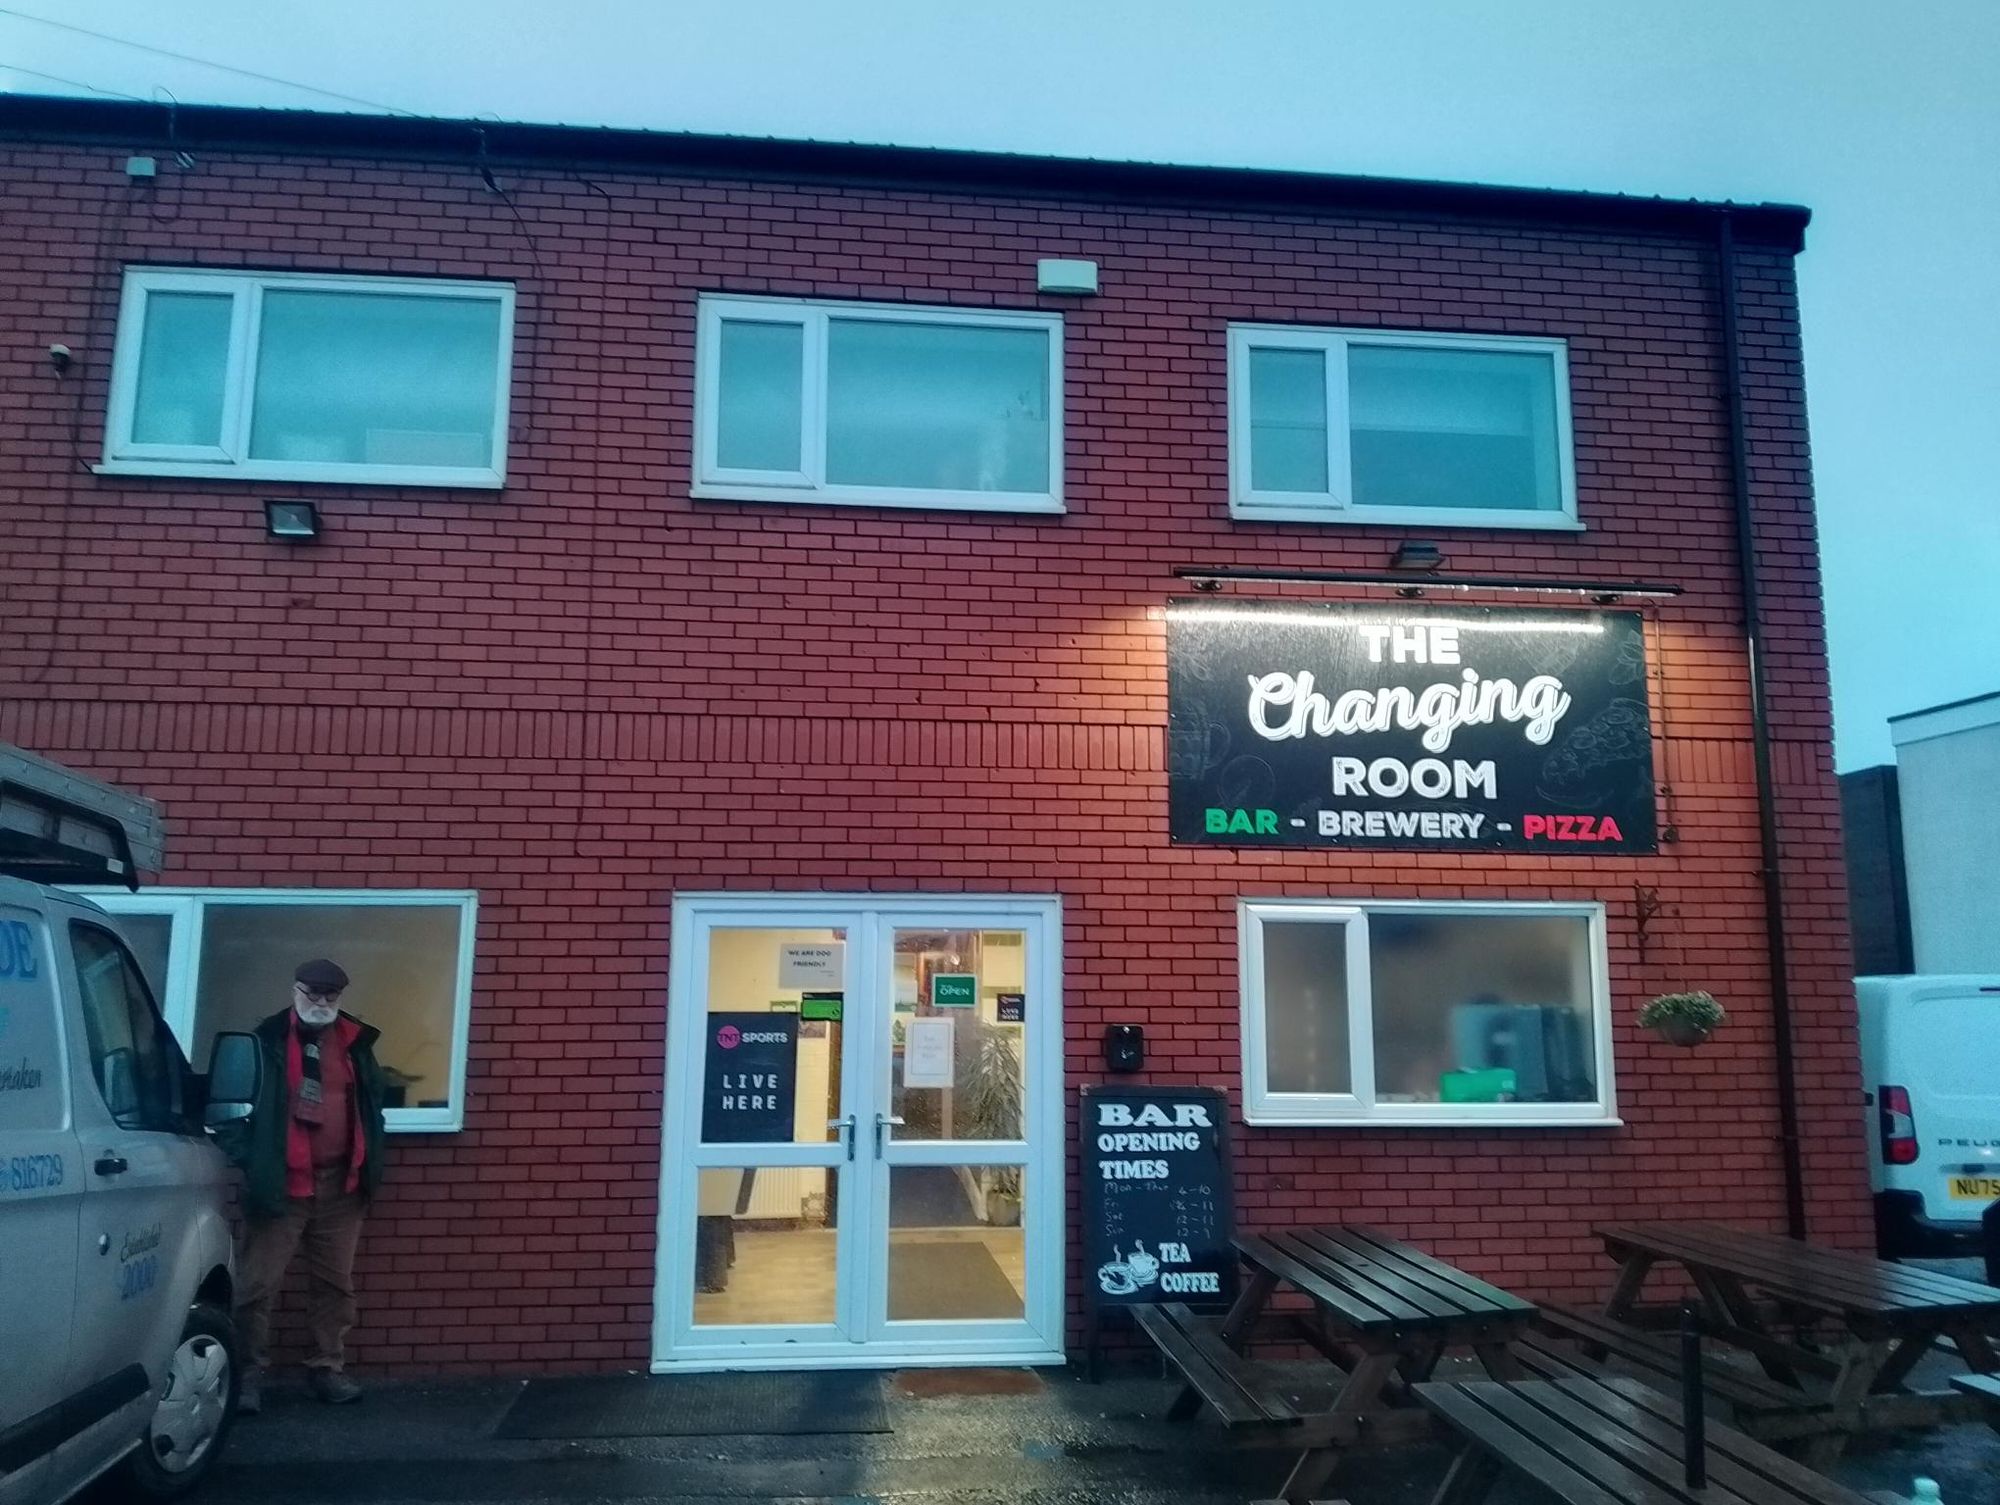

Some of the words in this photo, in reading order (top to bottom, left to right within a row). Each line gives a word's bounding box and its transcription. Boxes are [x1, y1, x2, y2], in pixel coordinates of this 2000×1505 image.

[1359, 624, 1462, 665] THE
[1247, 668, 1572, 753] Changing
[1331, 756, 1498, 800] ROOM
[1205, 808, 1280, 836] BAR
[1317, 810, 1485, 840] BREWERY
[1522, 814, 1623, 842] PIZZA
[742, 1032, 788, 1043] SPORTS
[722, 1073, 778, 1089] LIVE
[722, 1094, 777, 1110] HERE
[1097, 1103, 1213, 1127] BAR
[1097, 1131, 1201, 1152] OPENING
[1098, 1159, 1169, 1179] TIMES
[1158, 1242, 1192, 1263] TEA
[1160, 1272, 1221, 1292] COFFEE
